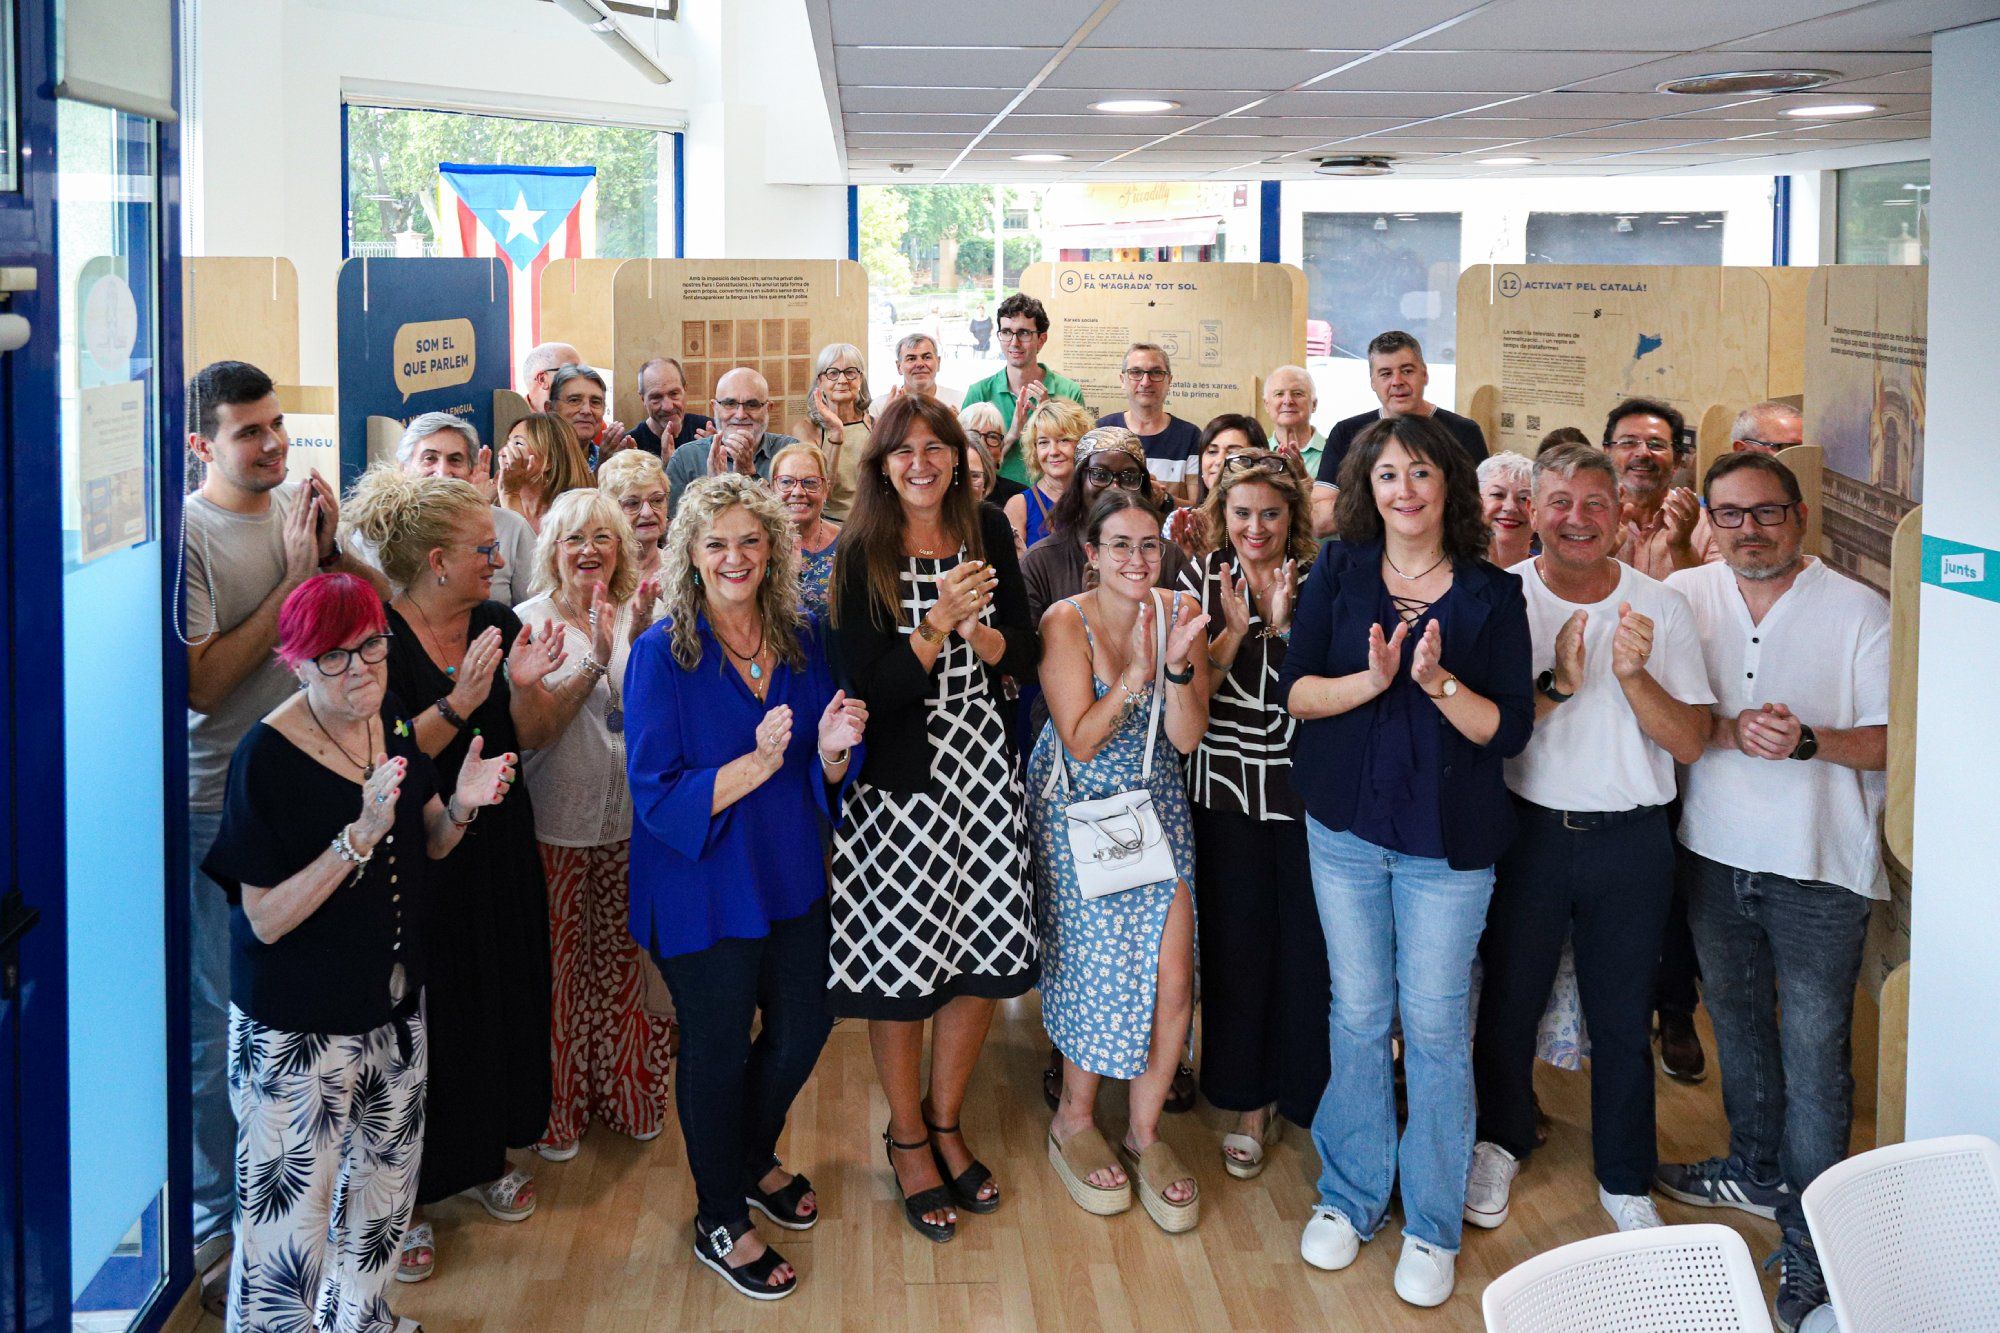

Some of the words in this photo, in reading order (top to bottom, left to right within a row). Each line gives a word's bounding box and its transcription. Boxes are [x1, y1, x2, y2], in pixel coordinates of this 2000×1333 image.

[1099, 272, 1135, 280] CATALÀ
[1066, 277, 1074, 286] 8
[1503, 280, 1517, 290] 12
[1524, 282, 1572, 290] ACTIVA'T
[416, 338, 438, 353] SOM
[443, 337, 454, 349] EL
[403, 360, 427, 377] QUE
[430, 354, 468, 372] PARLEM
[288, 438, 333, 448] LENGU
[1944, 559, 1977, 578] junts
